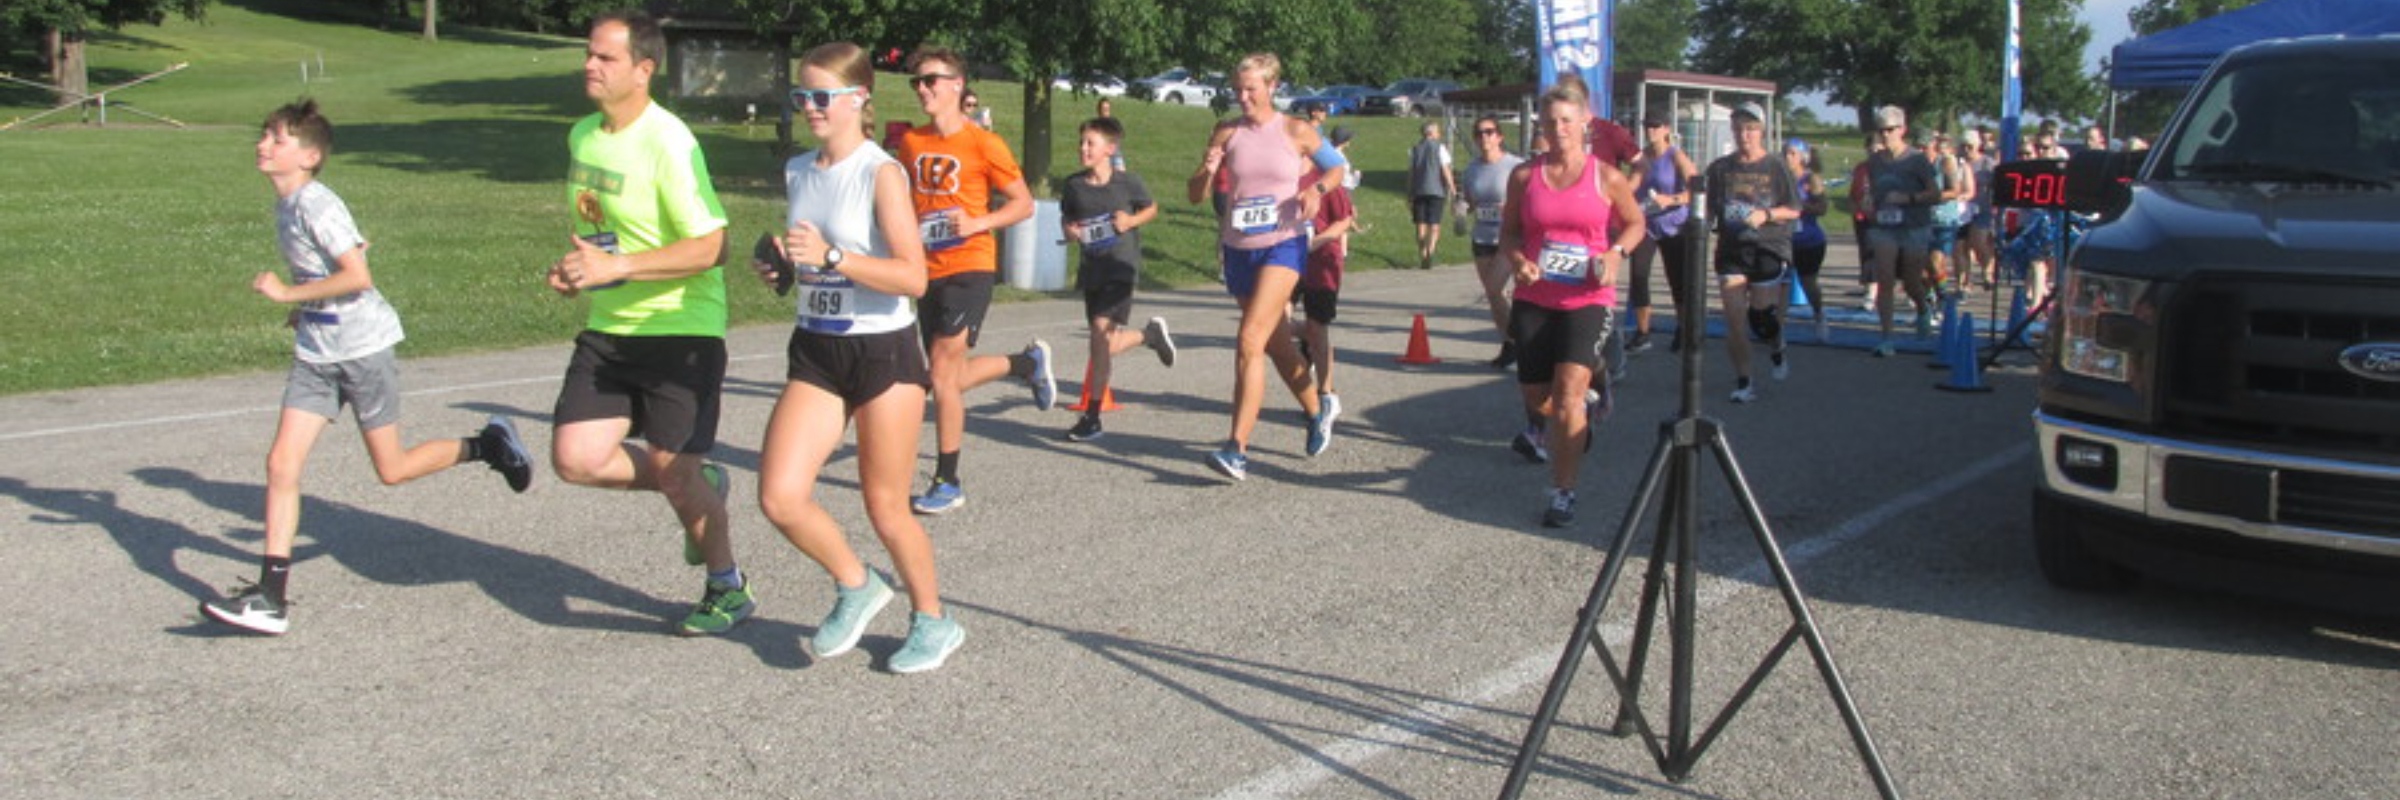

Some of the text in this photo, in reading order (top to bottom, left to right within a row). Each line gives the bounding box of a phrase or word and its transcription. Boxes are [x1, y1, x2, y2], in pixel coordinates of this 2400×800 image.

[1242, 207, 1270, 224] 476
[929, 221, 952, 239] 47
[1547, 254, 1579, 275] 222
[808, 290, 842, 315] 469
